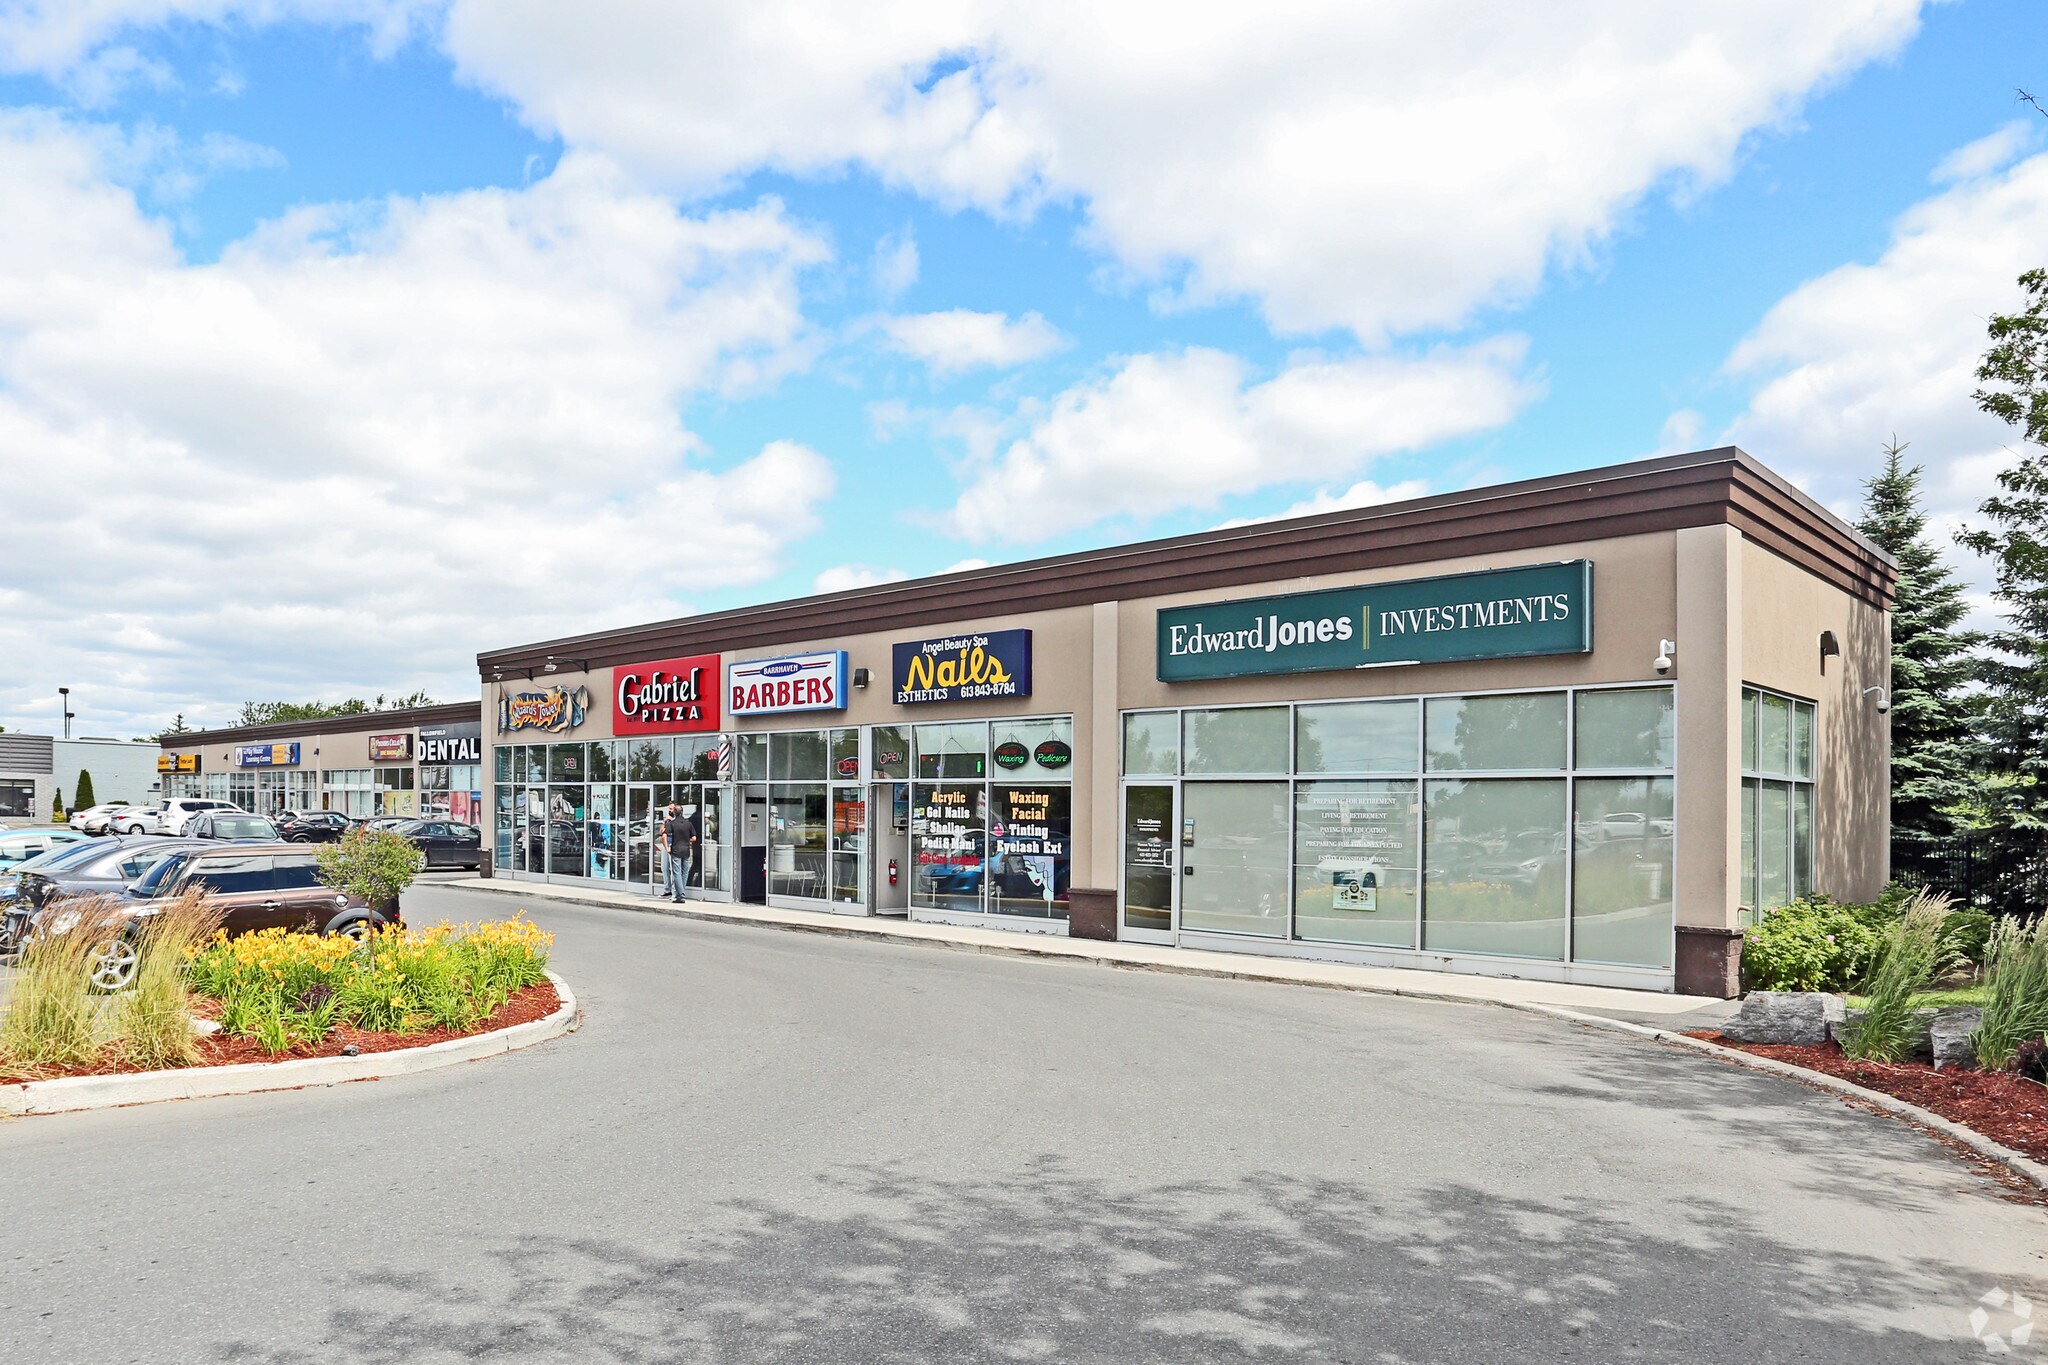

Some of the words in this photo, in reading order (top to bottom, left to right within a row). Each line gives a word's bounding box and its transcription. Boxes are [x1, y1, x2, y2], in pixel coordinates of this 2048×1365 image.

[1168, 614, 1353, 656] EdwardJones
[1379, 593, 1570, 637] INVESTMENTS
[921, 642, 944, 656] Angel
[944, 638, 972, 652] Beauty
[973, 635, 988, 648] Spa
[763, 664, 799, 675] BARRHAVEN
[901, 647, 1012, 692] Nails
[618, 667, 699, 716] Gabriel
[732, 676, 834, 710] BARBERS
[898, 688, 948, 703] ESTHETICS
[961, 687, 974, 698] 613
[974, 682, 1016, 696] 843-8784
[537, 702, 557, 721] Tower
[642, 705, 699, 723] PIZZA
[418, 738, 480, 761] DENTAL
[707, 751, 719, 760] OPE
[880, 752, 903, 764] OPEN
[998, 755, 1024, 764] Waxing
[1037, 753, 1068, 763] Pedicure
[931, 791, 966, 806] Acrylic
[1009, 791, 1049, 807] Waxing
[926, 806, 942, 819] Gel
[944, 806, 971, 819] Nails
[1012, 807, 1046, 820] Facial
[1349, 812, 1387, 820] RETIREMENT
[930, 822, 966, 834] Shellac
[1009, 824, 1049, 840] Tinting
[1341, 826, 1353, 834] FOR
[1353, 826, 1388, 834] EDUCATION
[921, 837, 943, 849] Pedi
[951, 837, 976, 851] Mani
[996, 840, 1040, 855] Eyelash
[1043, 842, 1062, 854] Ext
